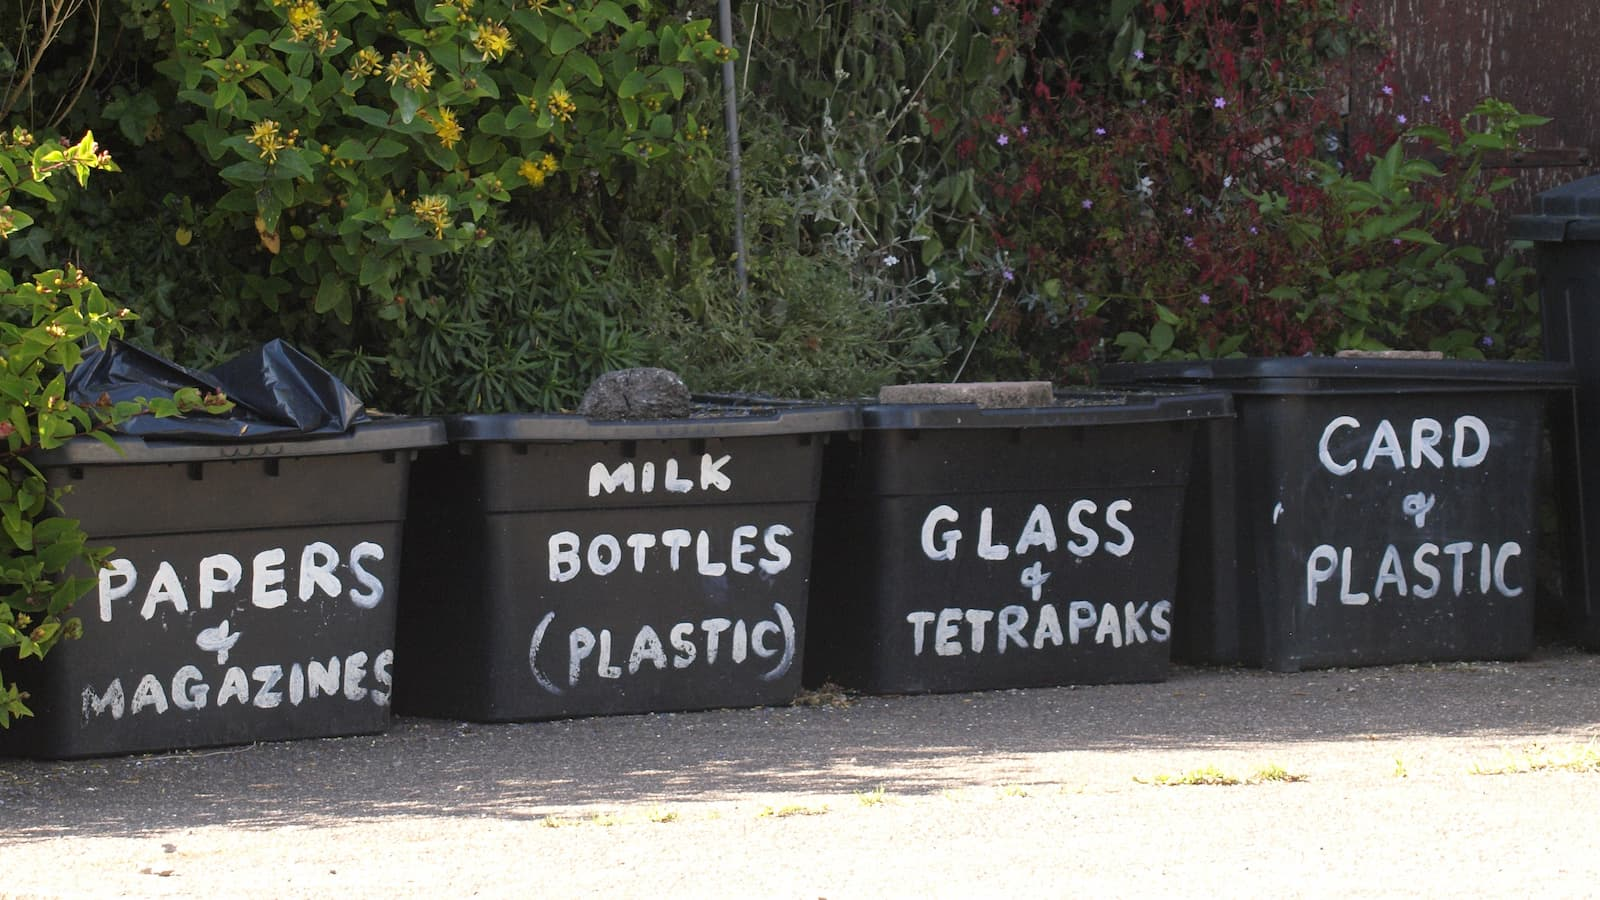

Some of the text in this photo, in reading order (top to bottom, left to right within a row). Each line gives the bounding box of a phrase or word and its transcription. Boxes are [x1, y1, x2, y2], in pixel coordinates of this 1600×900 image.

[588, 453, 732, 498] MILK
[1318, 415, 1491, 477] CARD
[921, 499, 1135, 561] GLASS
[1402, 491, 1436, 529] &
[97, 541, 385, 623] PAPERS
[547, 524, 793, 583] BOTTLES
[1020, 561, 1051, 602] &
[1306, 541, 1523, 607] PLASTIC
[195, 619, 243, 665] &
[906, 600, 1172, 657] TETRAPAKS
[81, 648, 394, 722] MAGAZINES
